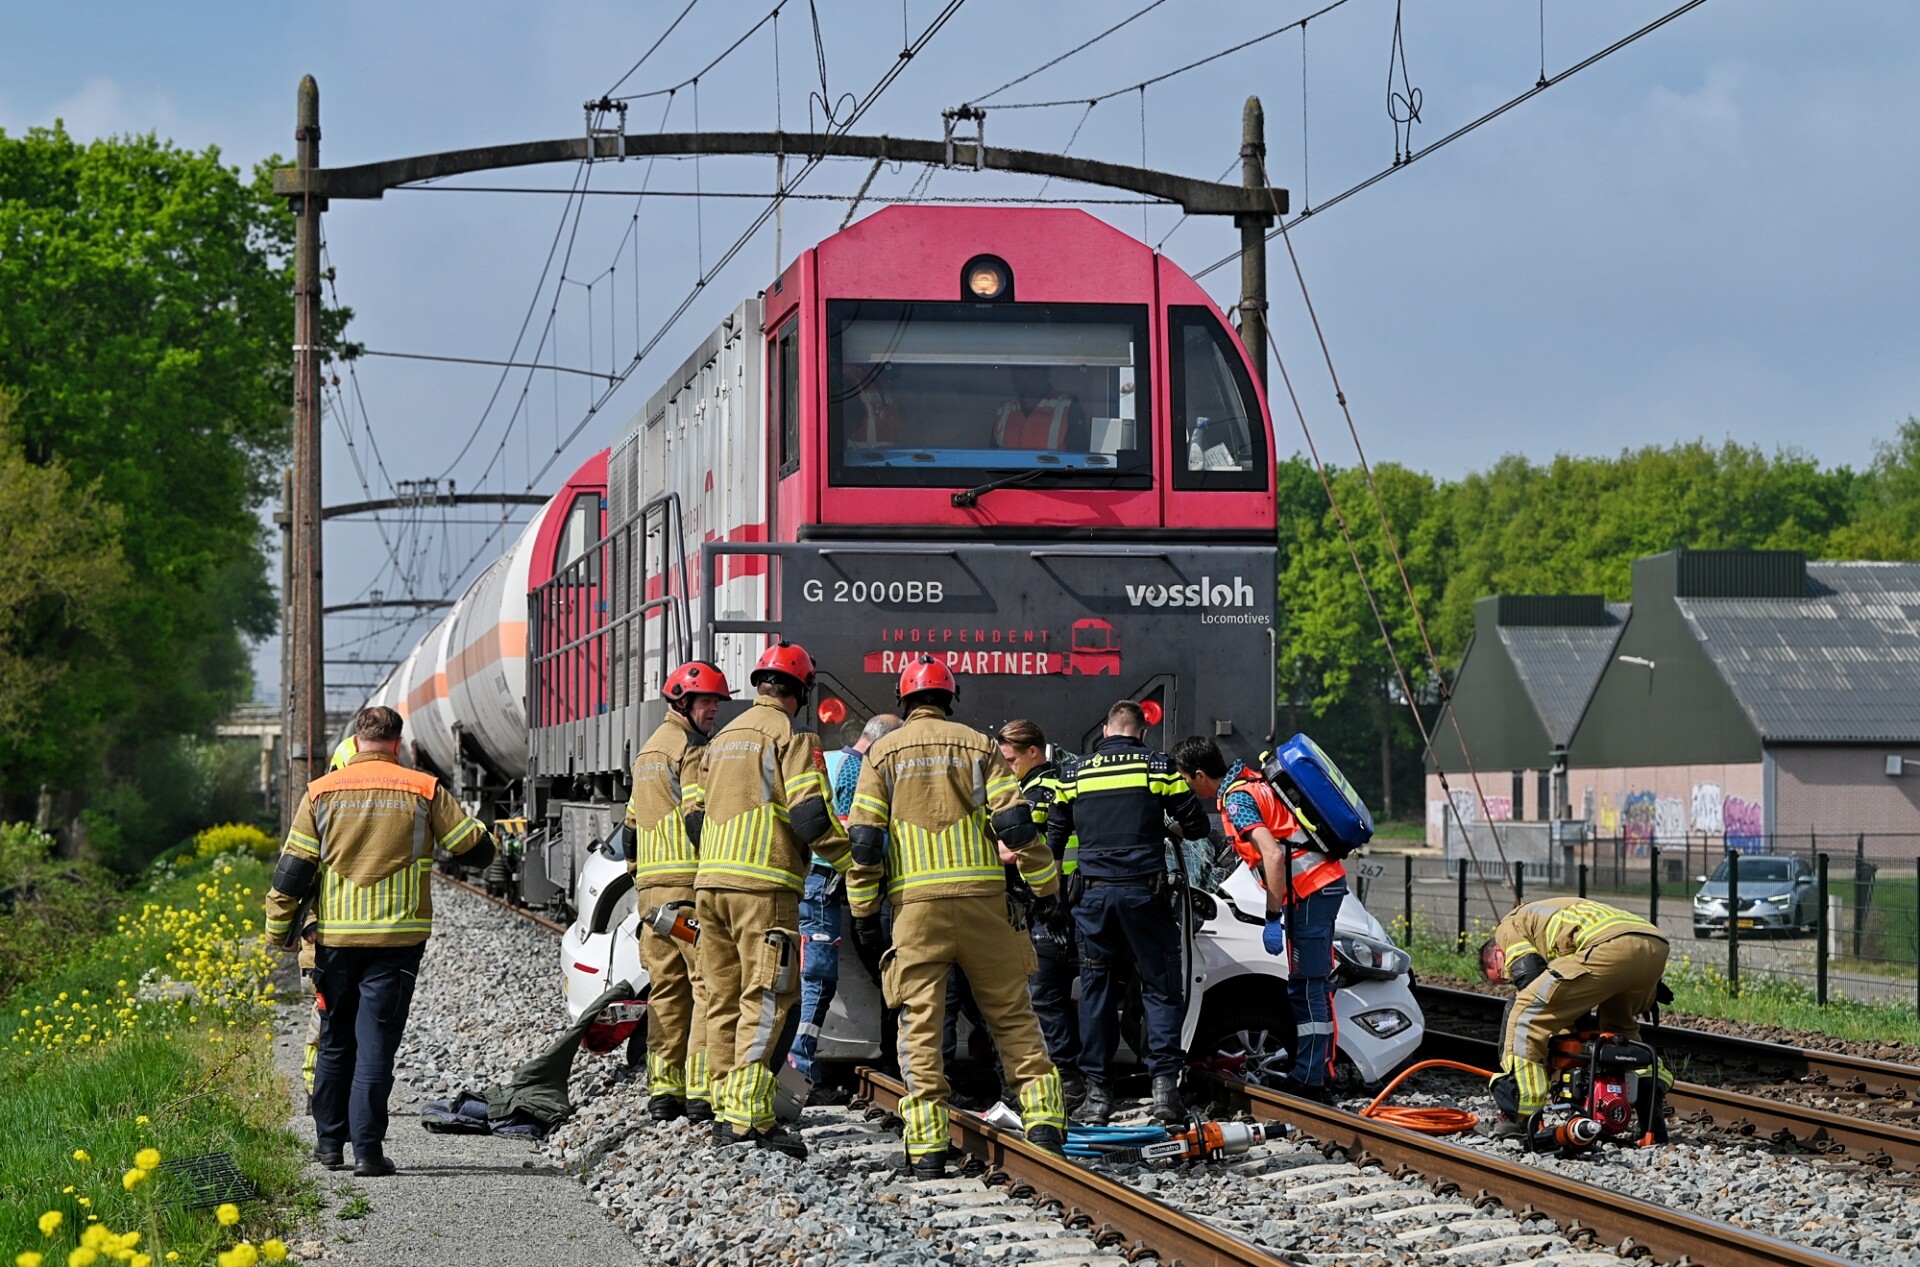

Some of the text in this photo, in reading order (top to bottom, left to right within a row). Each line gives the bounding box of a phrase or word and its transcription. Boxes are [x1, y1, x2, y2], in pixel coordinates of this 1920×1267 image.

[803, 579, 944, 603] G 2000BB
[1125, 576, 1254, 607] vossloh
[1201, 612, 1270, 624] Locomotives
[882, 628, 1049, 643] INDEPENDENT
[882, 650, 1048, 675] RA PARTNER
[332, 799, 408, 810] BRANDWEER
